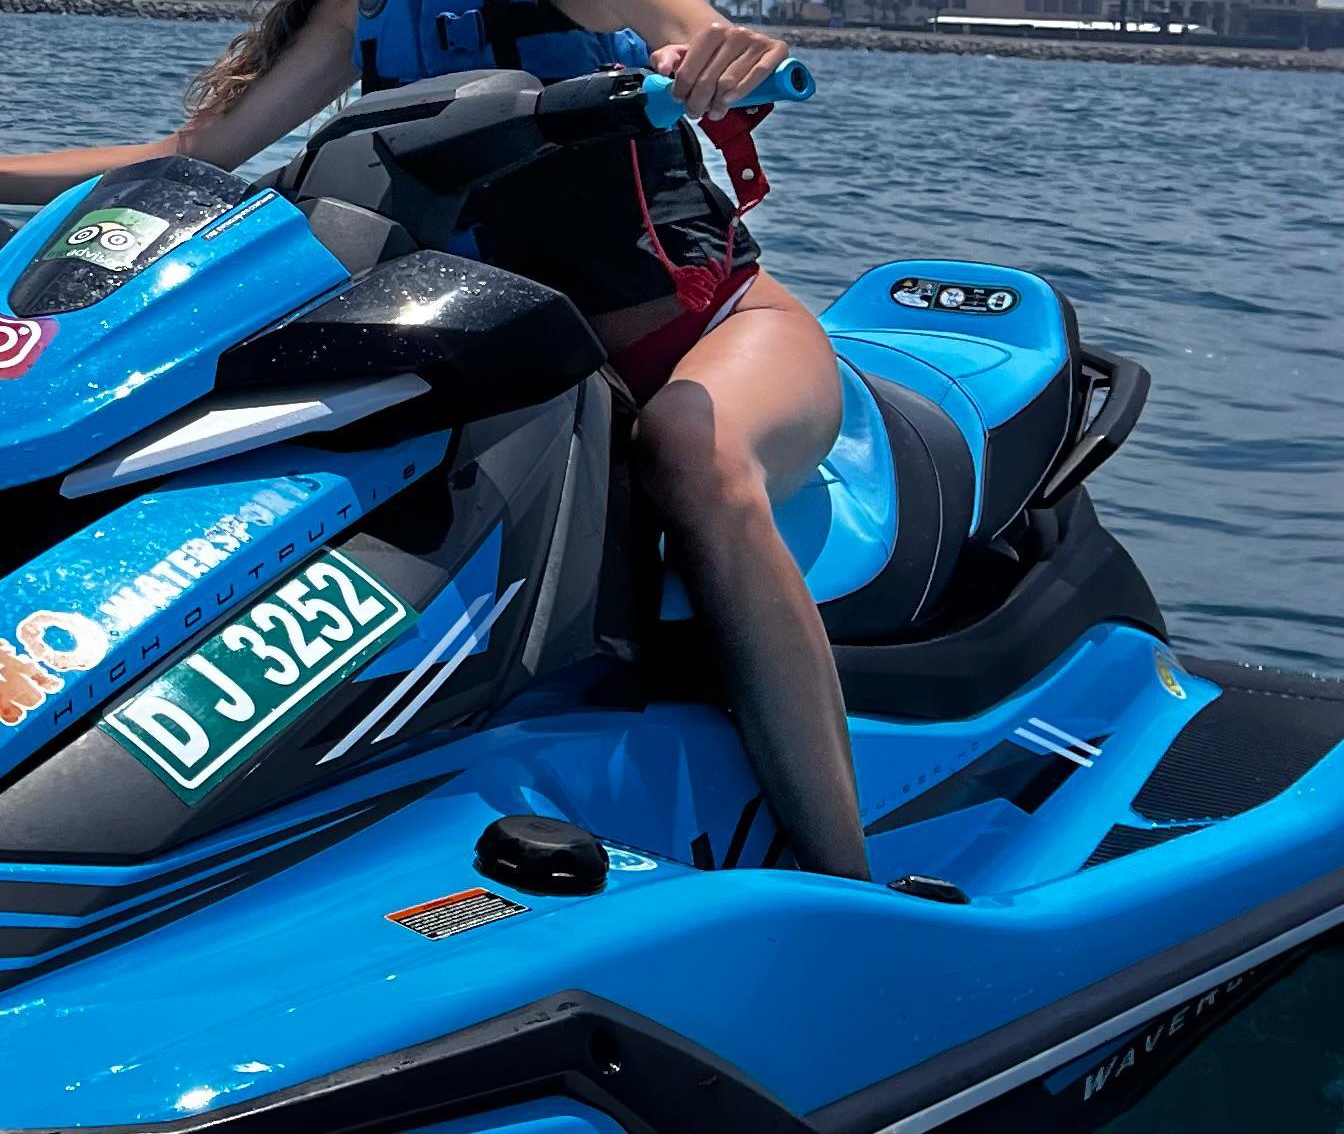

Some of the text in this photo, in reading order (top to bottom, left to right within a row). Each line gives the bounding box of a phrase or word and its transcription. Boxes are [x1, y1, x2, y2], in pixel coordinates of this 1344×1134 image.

[53, 635, 161, 726] HIGH
[184, 503, 353, 629] OUTPUT
[123, 561, 386, 769] D J 3252
